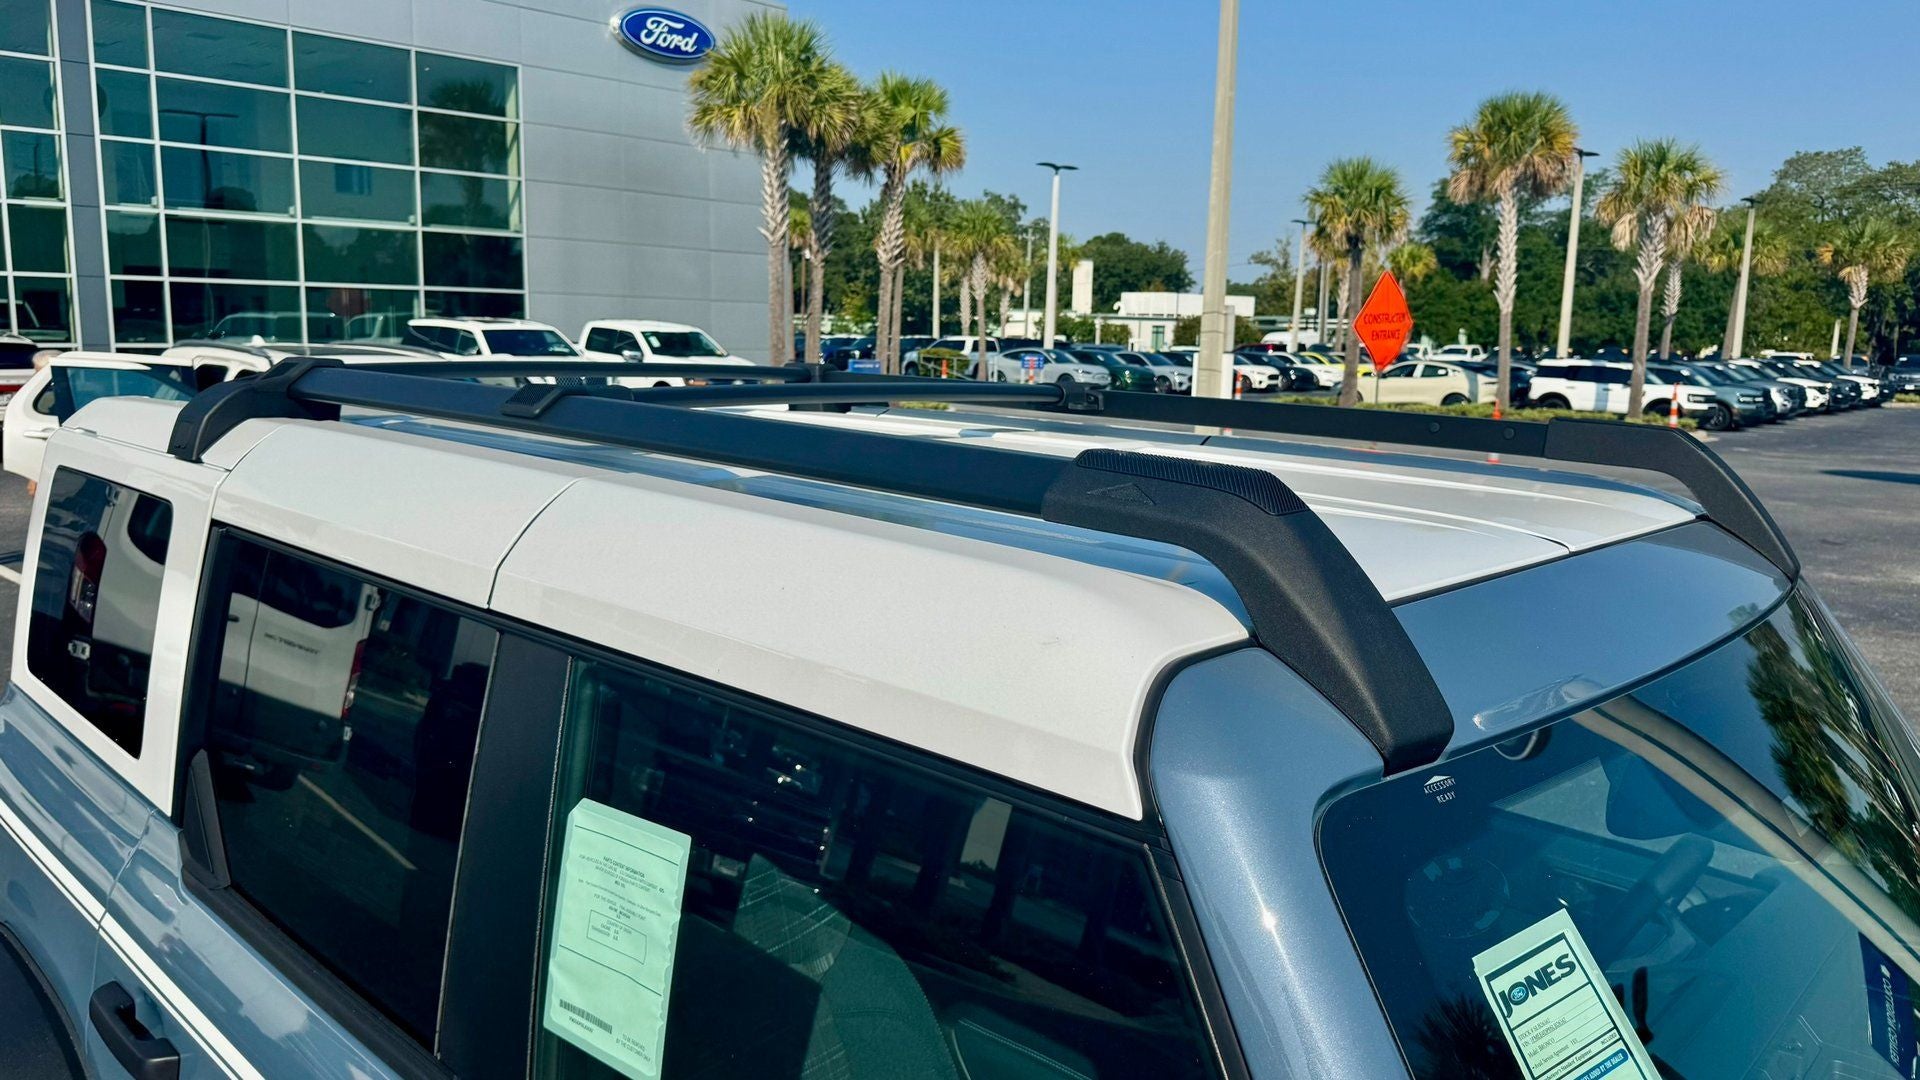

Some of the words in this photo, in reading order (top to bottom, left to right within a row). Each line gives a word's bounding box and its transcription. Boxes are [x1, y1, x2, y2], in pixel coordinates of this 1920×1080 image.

[640, 17, 699, 53] Ford
[1371, 329, 1401, 341] ENTRANCE
[1423, 777, 1456, 795] ACCESSORY
[1436, 790, 1456, 803] READY
[1498, 953, 1577, 1018] JONES
